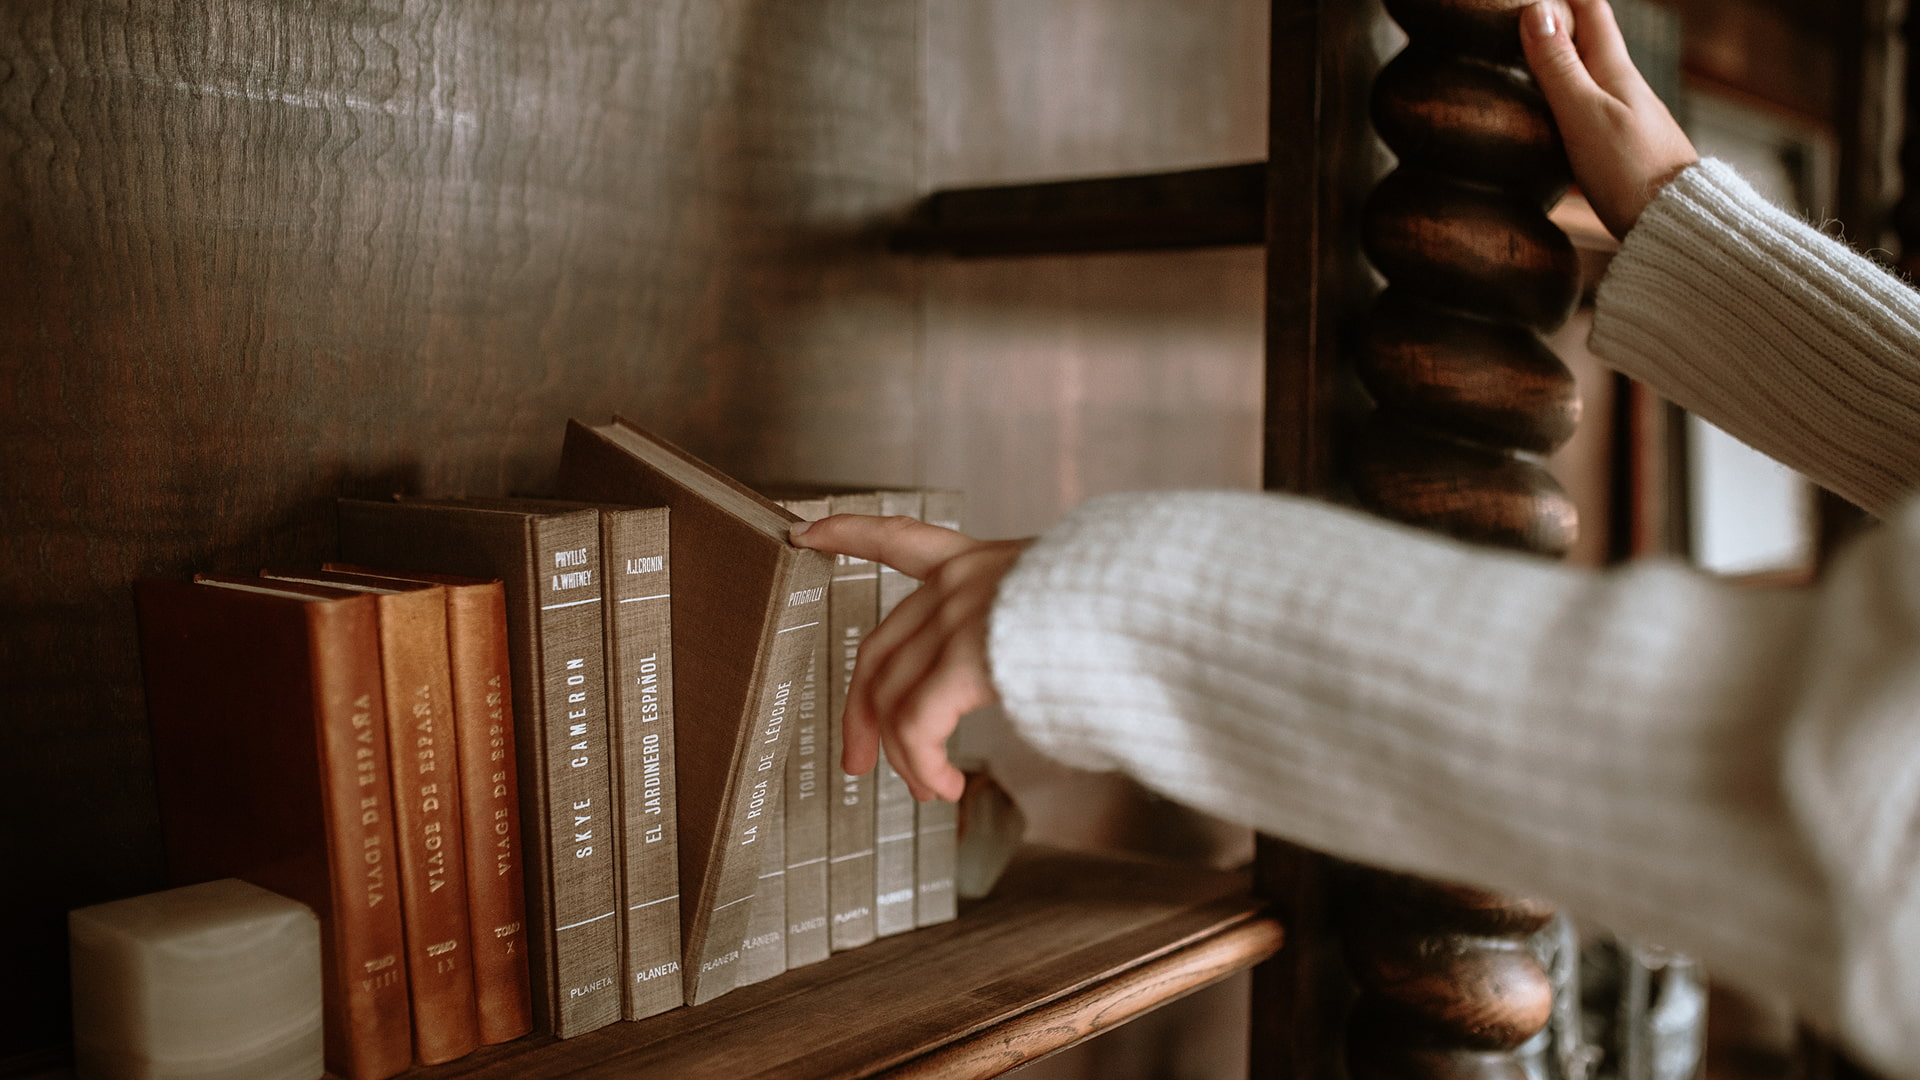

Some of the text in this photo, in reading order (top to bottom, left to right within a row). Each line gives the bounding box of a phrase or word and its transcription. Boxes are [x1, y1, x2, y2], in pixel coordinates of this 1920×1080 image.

[555, 548, 587, 568] PHYLLIS
[788, 587, 823, 607] PITIGRILLI
[637, 652, 662, 844] EL JARDINERO ESPAÑOL
[800, 725, 815, 756] UNA
[566, 658, 593, 859] SKYE CAMERON
[758, 752, 775, 772] DE
[486, 674, 512, 876] VIAGE DE ESPAÑA
[800, 761, 816, 799] TODA
[412, 684, 446, 893] VIAGE DE ESPAÑA
[747, 780, 768, 819] ROCA
[351, 694, 384, 908] VIAGE DE ESPAÑA
[741, 825, 758, 845] LA
[506, 941, 515, 954] X
[741, 931, 780, 951] PLANETA
[636, 961, 679, 983] PLANETA
[702, 950, 739, 973] PLANETA
[570, 977, 613, 999] PLANETA
